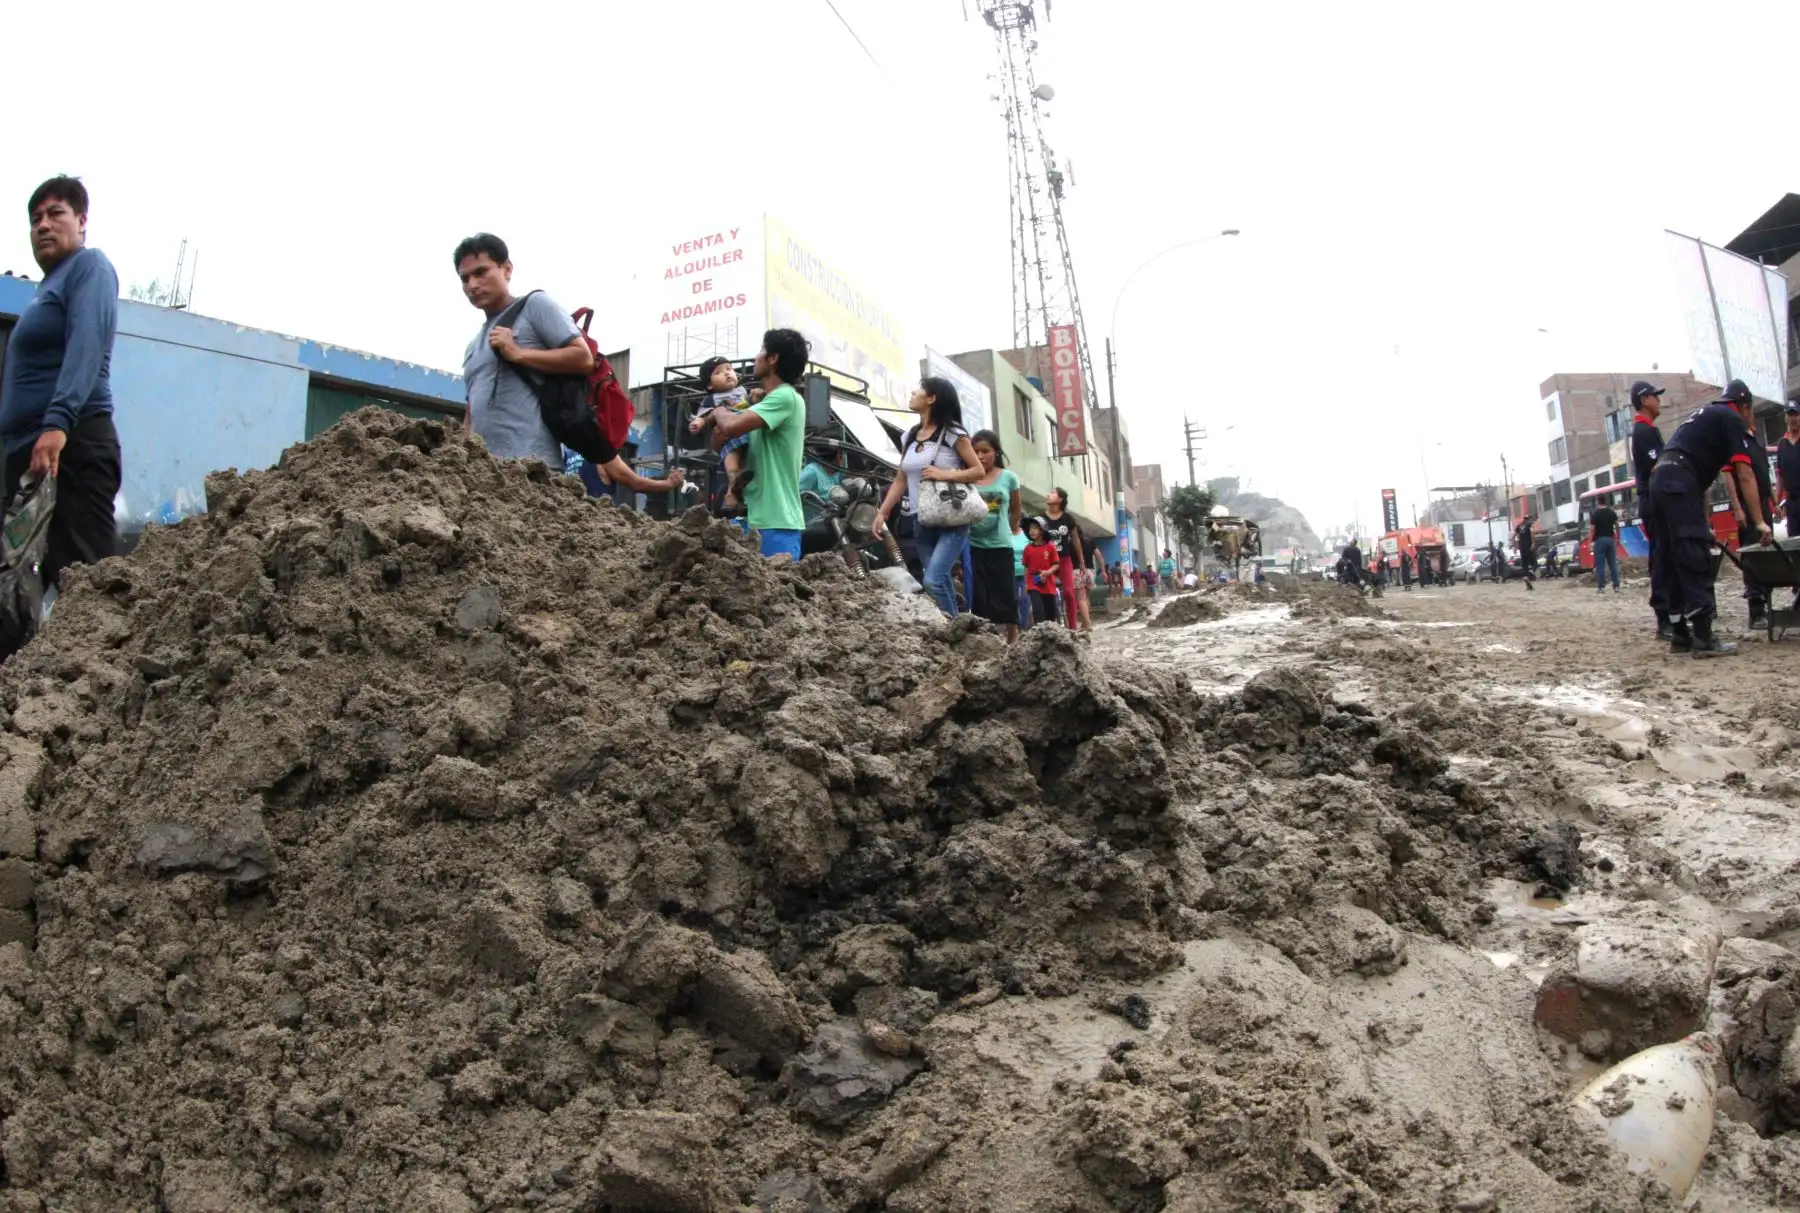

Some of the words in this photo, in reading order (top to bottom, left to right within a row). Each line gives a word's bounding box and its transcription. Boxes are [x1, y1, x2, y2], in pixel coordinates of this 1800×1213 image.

[672, 232, 724, 256] VENTA
[729, 227, 740, 240] Y
[664, 248, 744, 280] ALQUILER
[692, 278, 713, 294] DE
[660, 293, 747, 325] ANDAMIOS
[1053, 328, 1083, 451] BOTICA
